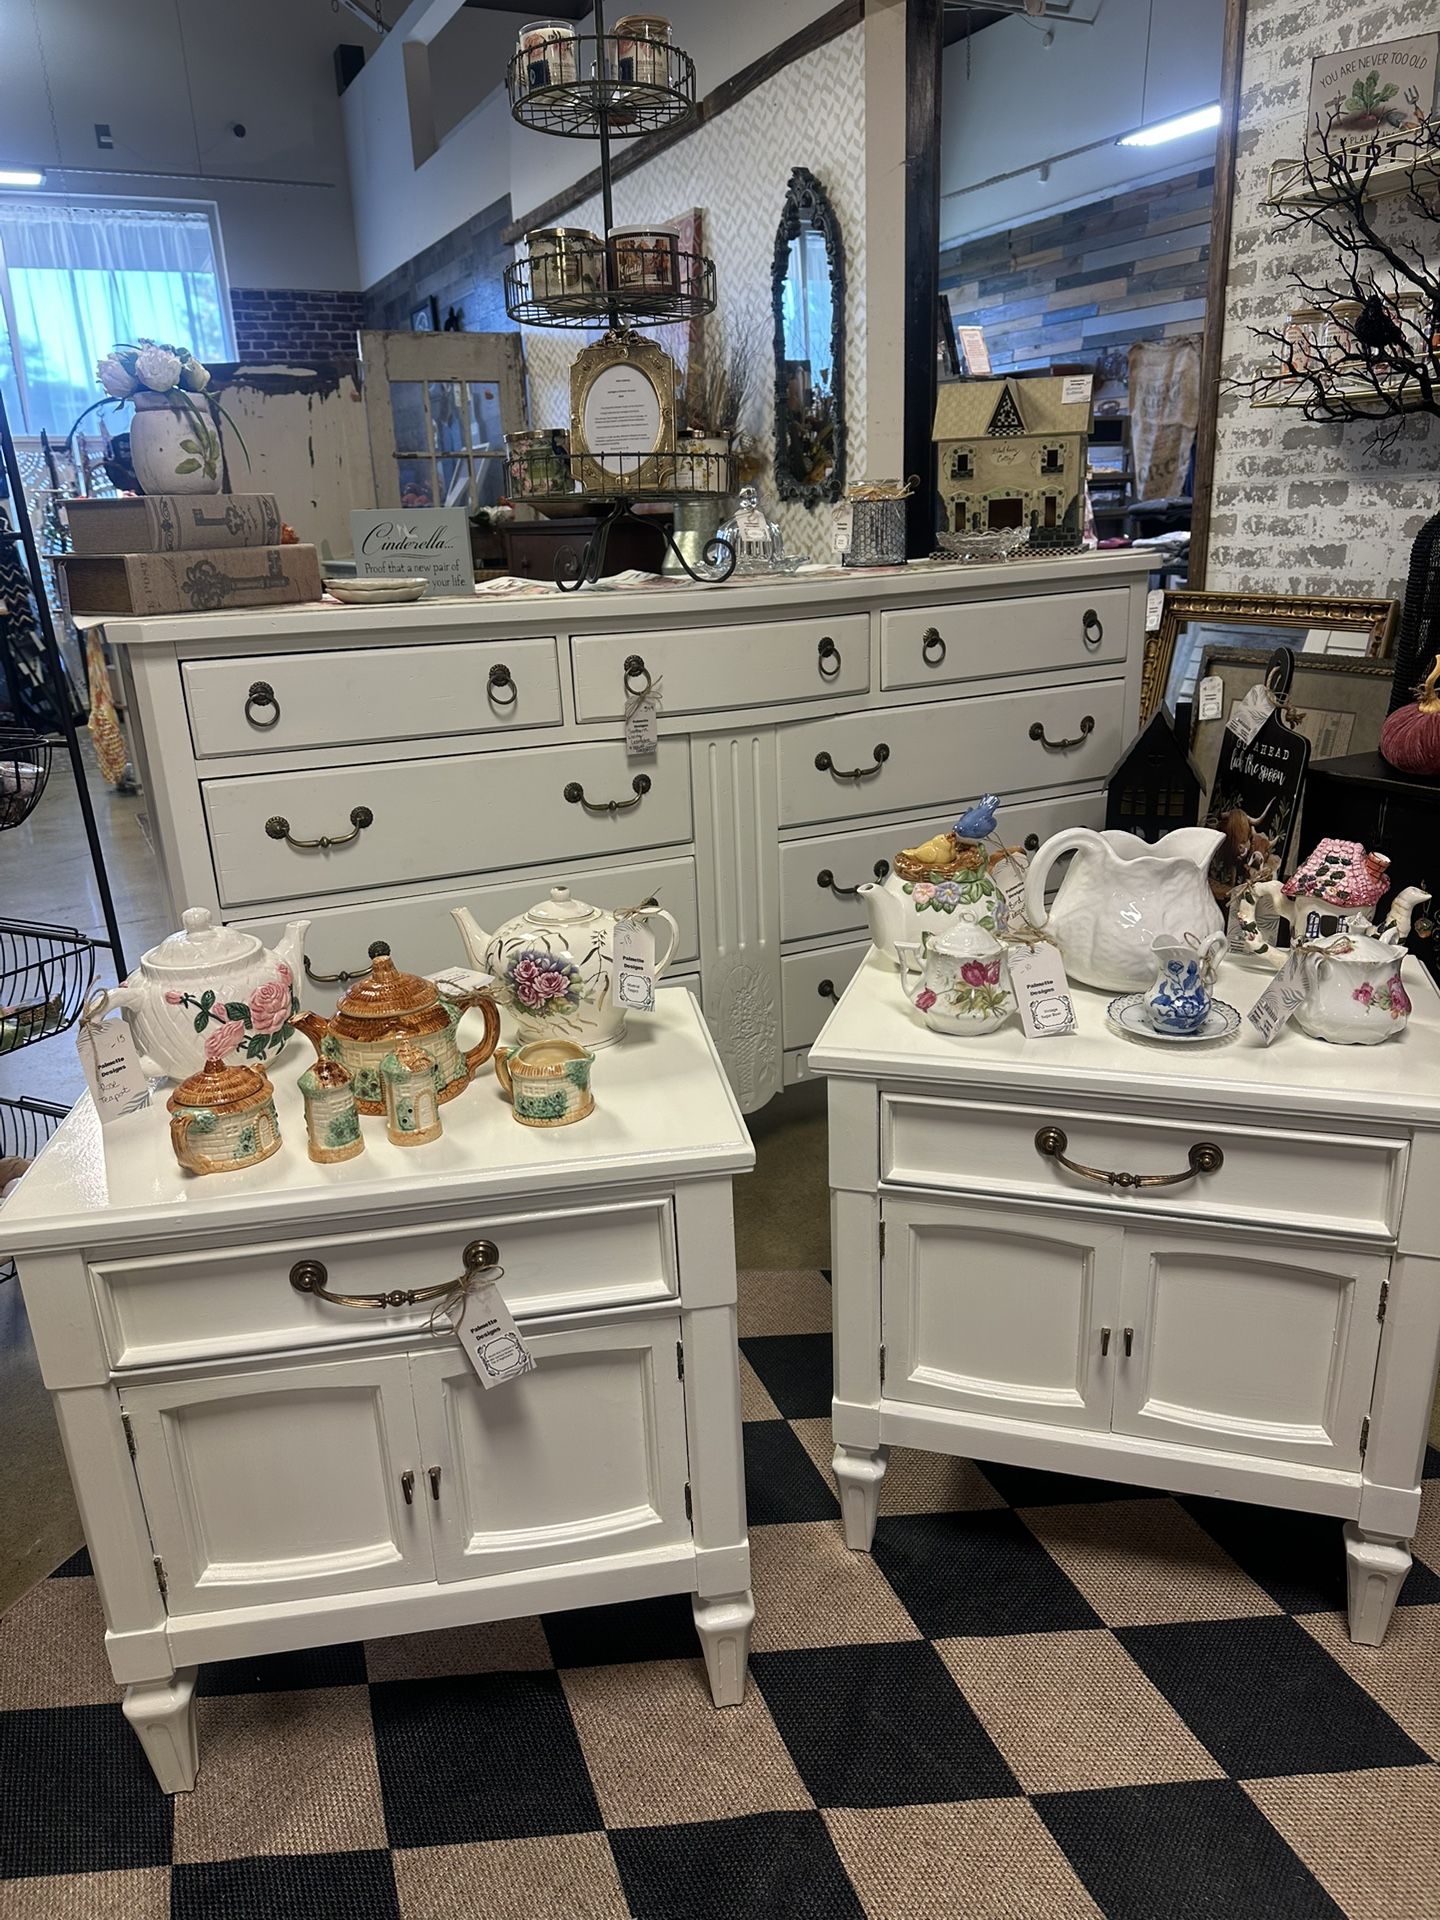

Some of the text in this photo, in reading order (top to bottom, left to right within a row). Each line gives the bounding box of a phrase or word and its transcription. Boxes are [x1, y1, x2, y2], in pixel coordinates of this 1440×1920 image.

[1319, 51, 1428, 88] YOU ARE NEVER TOO OLD
[365, 559, 460, 576] Proof that a new pair of
[431, 580, 450, 590] your
[1253, 741, 1290, 760] AHEAD
[1258, 764, 1286, 786] spoon
[623, 963, 644, 971] Designs
[1030, 987, 1055, 996] Designs
[101, 1065, 127, 1078] Designs
[476, 1327, 501, 1342] Designs
